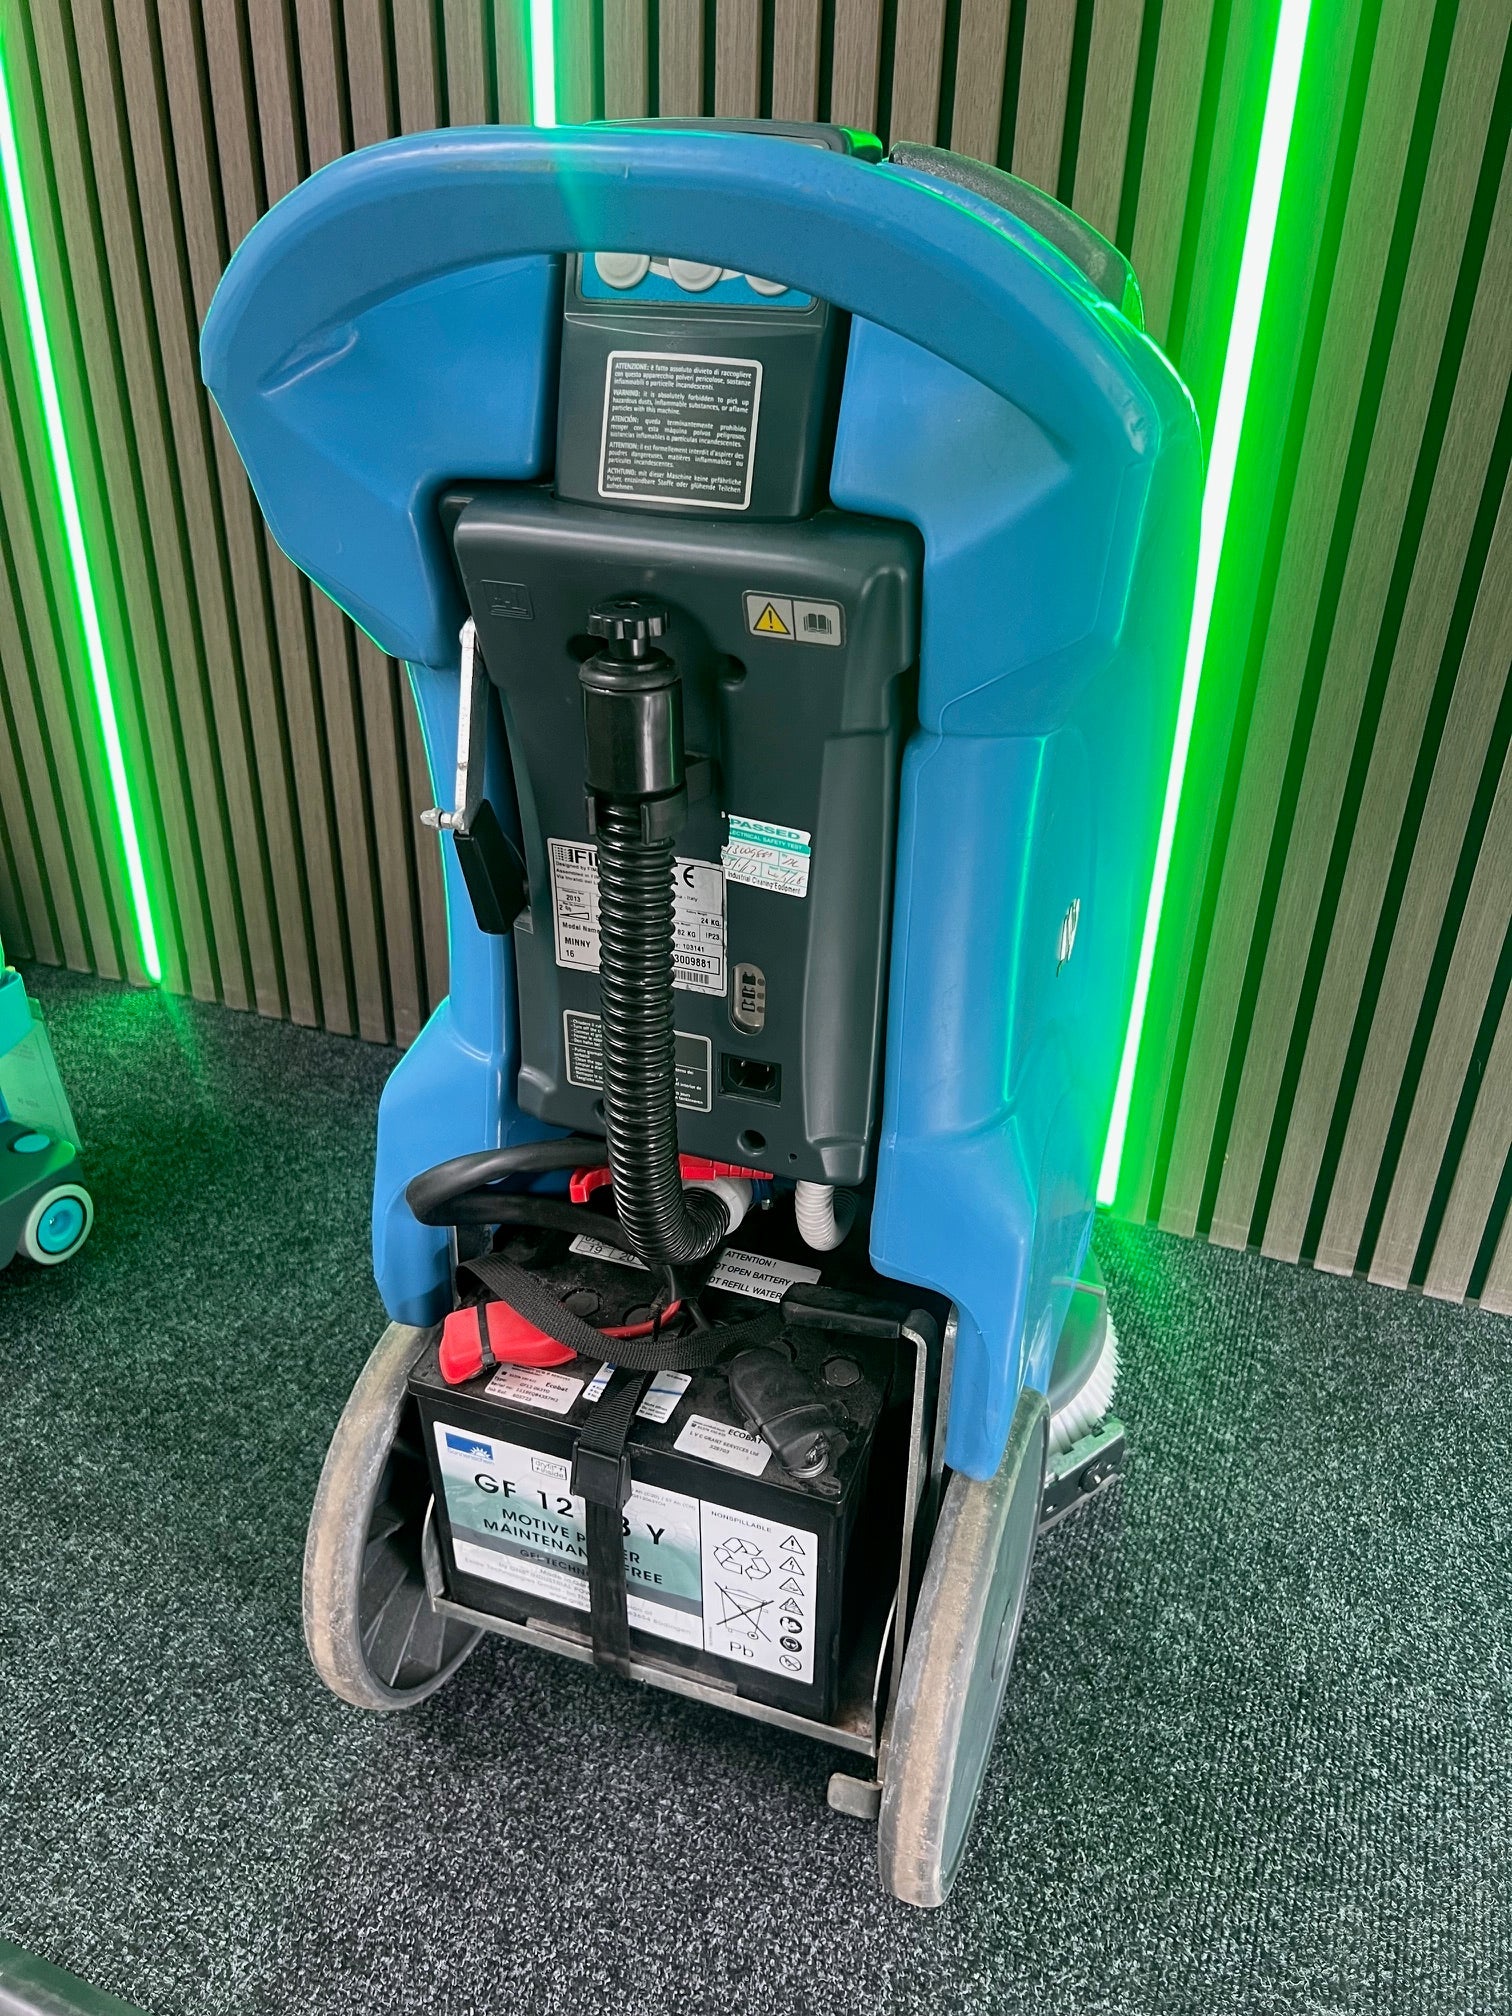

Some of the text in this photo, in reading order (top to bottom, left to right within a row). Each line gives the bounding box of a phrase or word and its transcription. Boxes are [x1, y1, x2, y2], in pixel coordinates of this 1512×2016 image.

[721, 370, 751, 378] raccogliere
[658, 392, 685, 400] absolutely
[688, 394, 714, 402] forbidden
[731, 818, 800, 840] PASSED
[762, 836, 802, 850] SAFETY TEST
[728, 871, 750, 883] Industrial
[566, 894, 580, 902] 2013
[562, 922, 581, 930] Model
[565, 936, 590, 948] MINNY
[706, 932, 720, 940] IP23
[566, 949, 575, 957] 16
[683, 943, 704, 952] 103141
[590, 1246, 603, 1254] 19
[725, 1250, 772, 1267] ATTENTION
[727, 1265, 751, 1277] OPEN
[752, 1272, 791, 1286] BATTERY
[721, 1280, 750, 1292] REFILL
[753, 1286, 782, 1299] WATER
[545, 1382, 568, 1392] Ecobat
[728, 1428, 761, 1445] ECOBAT
[475, 1473, 516, 1498] GF
[537, 1490, 574, 1518] 12
[646, 1523, 665, 1544] Y
[502, 1508, 570, 1538] MOTIVE
[711, 1510, 772, 1533] NONSPILLABLE
[483, 1519, 588, 1558] MAINTENAN
[729, 1641, 754, 1658] Pb
